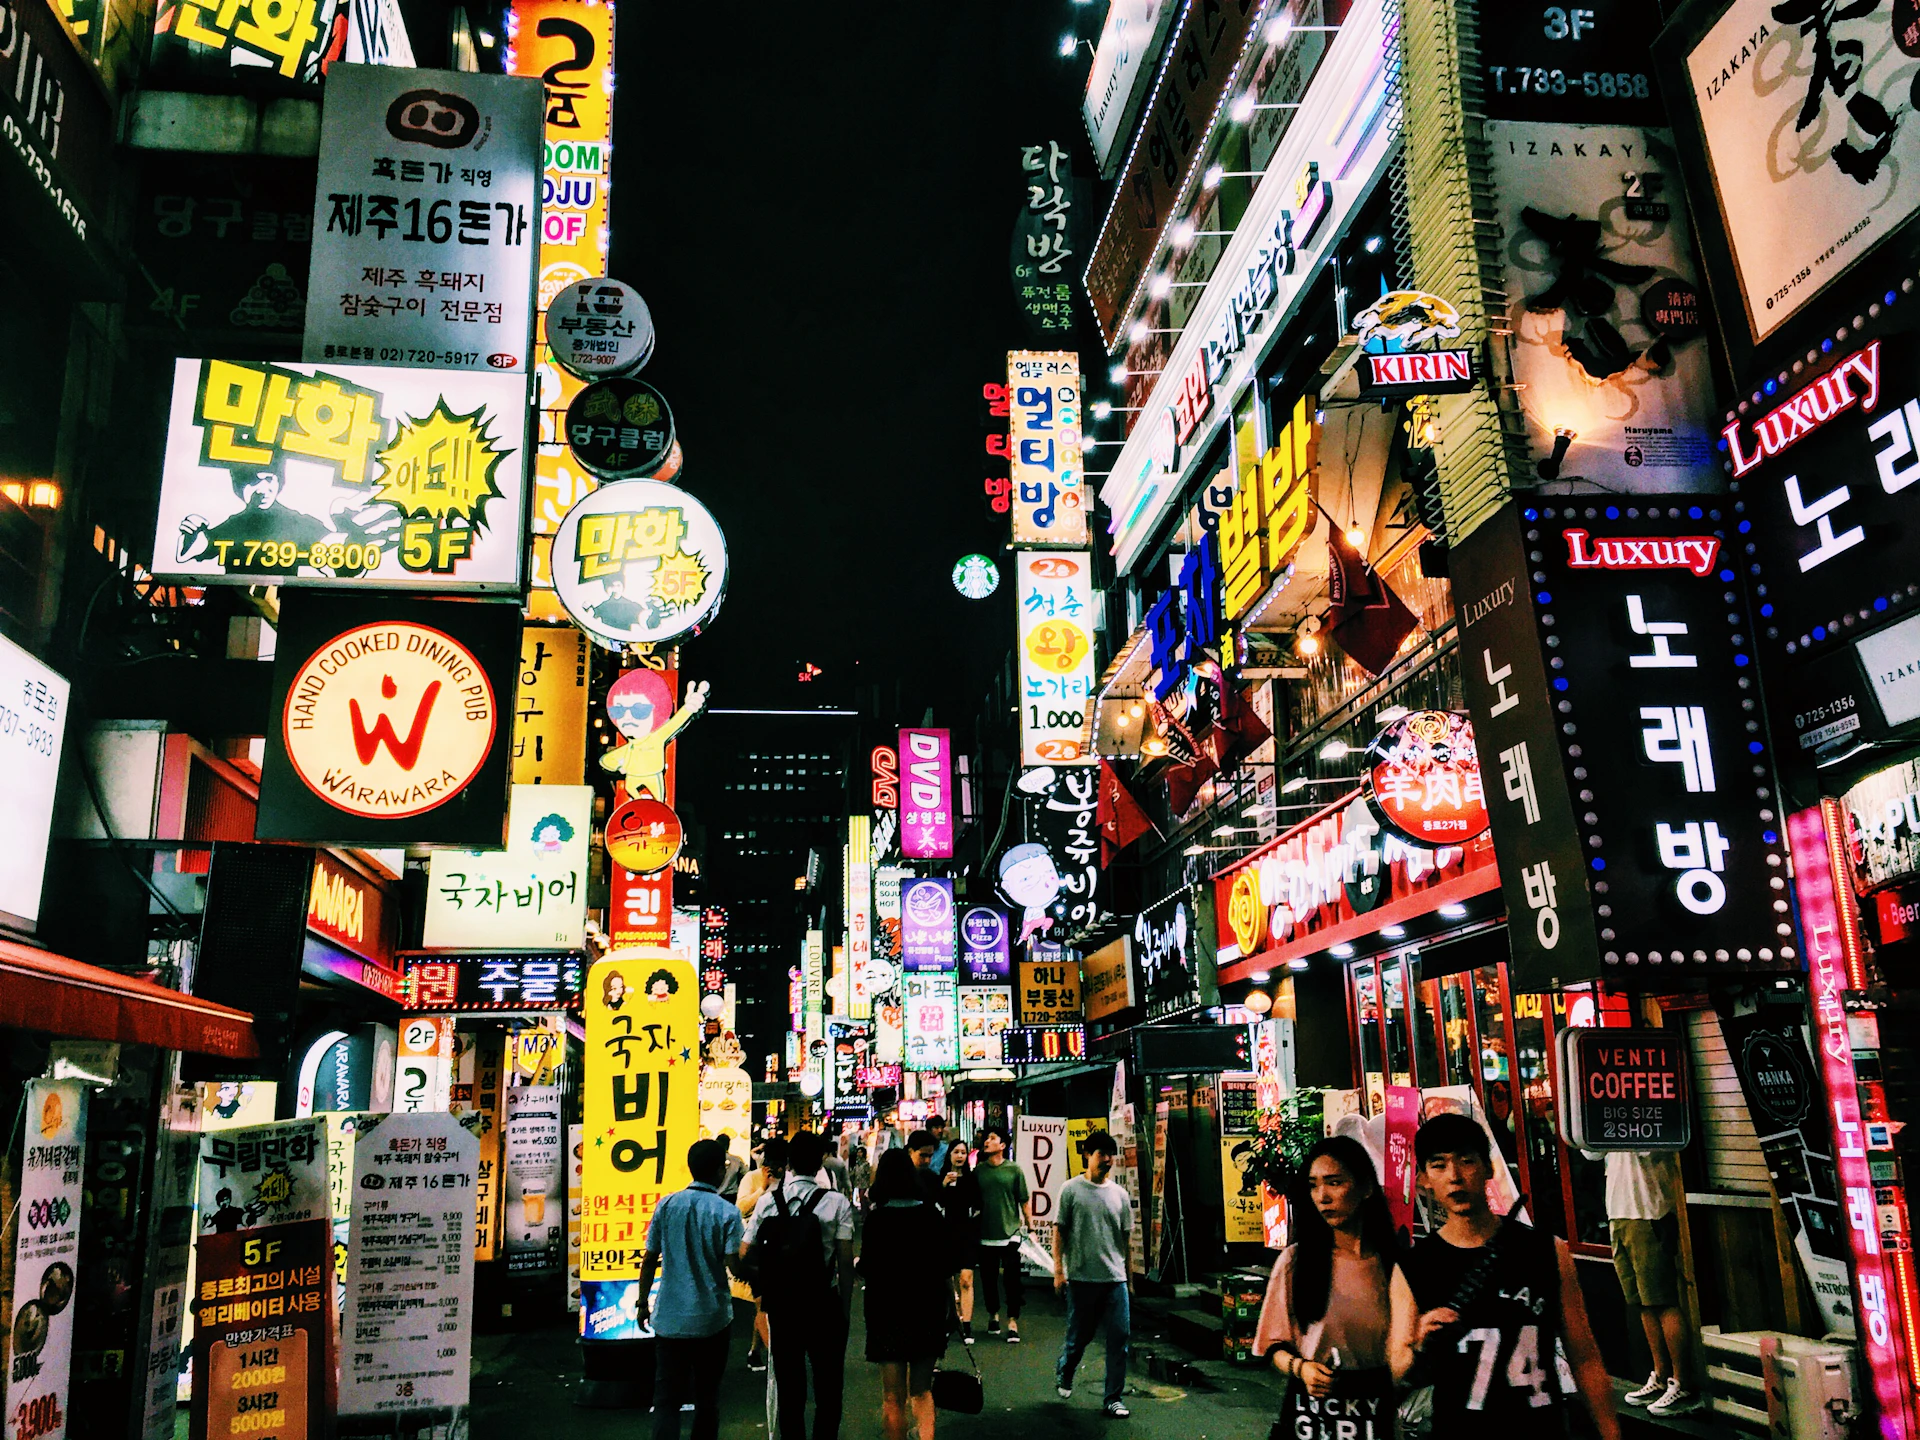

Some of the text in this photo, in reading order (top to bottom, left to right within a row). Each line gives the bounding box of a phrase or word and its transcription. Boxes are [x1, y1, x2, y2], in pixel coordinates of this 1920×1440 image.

[1543, 6, 1595, 41] 3F
[1705, 23, 1770, 102] IZAKAYA
[1488, 66, 1650, 99] T.733-5858
[1092, 66, 1121, 133] Luxury
[372, 157, 492, 187] 흑돈가 직영
[327, 193, 527, 246] 제주16돈가
[1020, 140, 1072, 273] 다락방
[361, 267, 484, 293] 제주 흑돼지
[1015, 264, 1033, 278] 6F
[1773, 265, 1813, 303] 725-1356
[339, 294, 502, 324] 참숯구이 전문점
[1024, 303, 1073, 315] 생맥주
[557, 316, 636, 339] 부동산
[1042, 316, 1073, 330] 소주
[324, 346, 375, 360] 종로본점
[571, 339, 619, 354] 중개법인
[492, 353, 514, 368] 3F
[1015, 361, 1074, 379] 엠플러스
[1371, 350, 1471, 386] KIRIN
[1176, 346, 1210, 447] 코인
[1723, 341, 1881, 478] Luxury
[203, 359, 381, 484] 만화
[1623, 426, 1674, 437] Haruyama
[571, 423, 665, 451] 당구클럽
[605, 453, 629, 467] 4F
[1017, 386, 1061, 529] 멀티방
[213, 540, 382, 570] T.739-8800
[404, 523, 468, 570] 5F
[579, 508, 684, 584] 만화
[1566, 531, 1719, 574] Luxury
[662, 569, 698, 596] 5F
[1024, 586, 1084, 618] 청춘
[1462, 575, 1517, 630] Luxury
[1034, 626, 1083, 670] 왕
[293, 632, 489, 731] HAND COOKED DINING PUB
[798, 672, 812, 682] SK
[1026, 675, 1091, 700] 노가리
[23, 680, 58, 721] 종로점
[1804, 695, 1856, 725] 725-1356
[1029, 704, 1084, 731] 1,000
[1624, 594, 1731, 916] 노래방
[908, 732, 942, 811] DVD
[321, 767, 458, 806] WARAWARA
[1482, 647, 1561, 950] 노래방
[905, 811, 947, 826] 상영관
[1422, 820, 1468, 831] 종로2가점
[922, 850, 934, 859] 3F
[440, 871, 578, 915] 국자비어
[614, 931, 668, 941] DASARANG
[967, 918, 998, 928] 퓨전짬뽕
[704, 909, 725, 991] 노래방
[971, 933, 993, 942] Pizza
[963, 951, 1004, 963] 퓨전짬뽕
[981, 964, 988, 973] &
[808, 944, 821, 998] LOUVRE
[972, 972, 998, 981] Pizza
[1033, 966, 1065, 985] 하나
[1026, 989, 1075, 1007] 부동산
[1812, 920, 1849, 1066] Luxury
[1023, 1011, 1081, 1023] T.720-3335
[409, 1027, 435, 1045] 2F
[524, 1036, 558, 1057] Max
[605, 1014, 677, 1069] 국자
[1598, 1048, 1667, 1067] VENTI
[1589, 1071, 1676, 1099] COFFEE
[1757, 1070, 1795, 1088] RANKA
[1603, 1106, 1663, 1120] BIG SIZE
[1022, 1120, 1065, 1136] Luxury
[203, 1135, 320, 1178] 무림만화
[388, 1137, 447, 1152] 흑돈가 직영
[1032, 1135, 1053, 1217] DVD
[1834, 1099, 1889, 1347] 노래방
[243, 1239, 283, 1266] 5F
[200, 1264, 321, 1302] 종로최고의 시설
[287, 1291, 321, 1313] 사용
[225, 1322, 296, 1348] 만화가격표
[238, 1348, 280, 1369] 1시간
[1456, 1324, 1552, 1411] 74
[230, 1366, 287, 1390] 2000원
[395, 1381, 415, 1397] 3층
[236, 1391, 280, 1413] 3시간
[1295, 1392, 1379, 1417] LUCKY
[229, 1410, 287, 1436] 5000원
